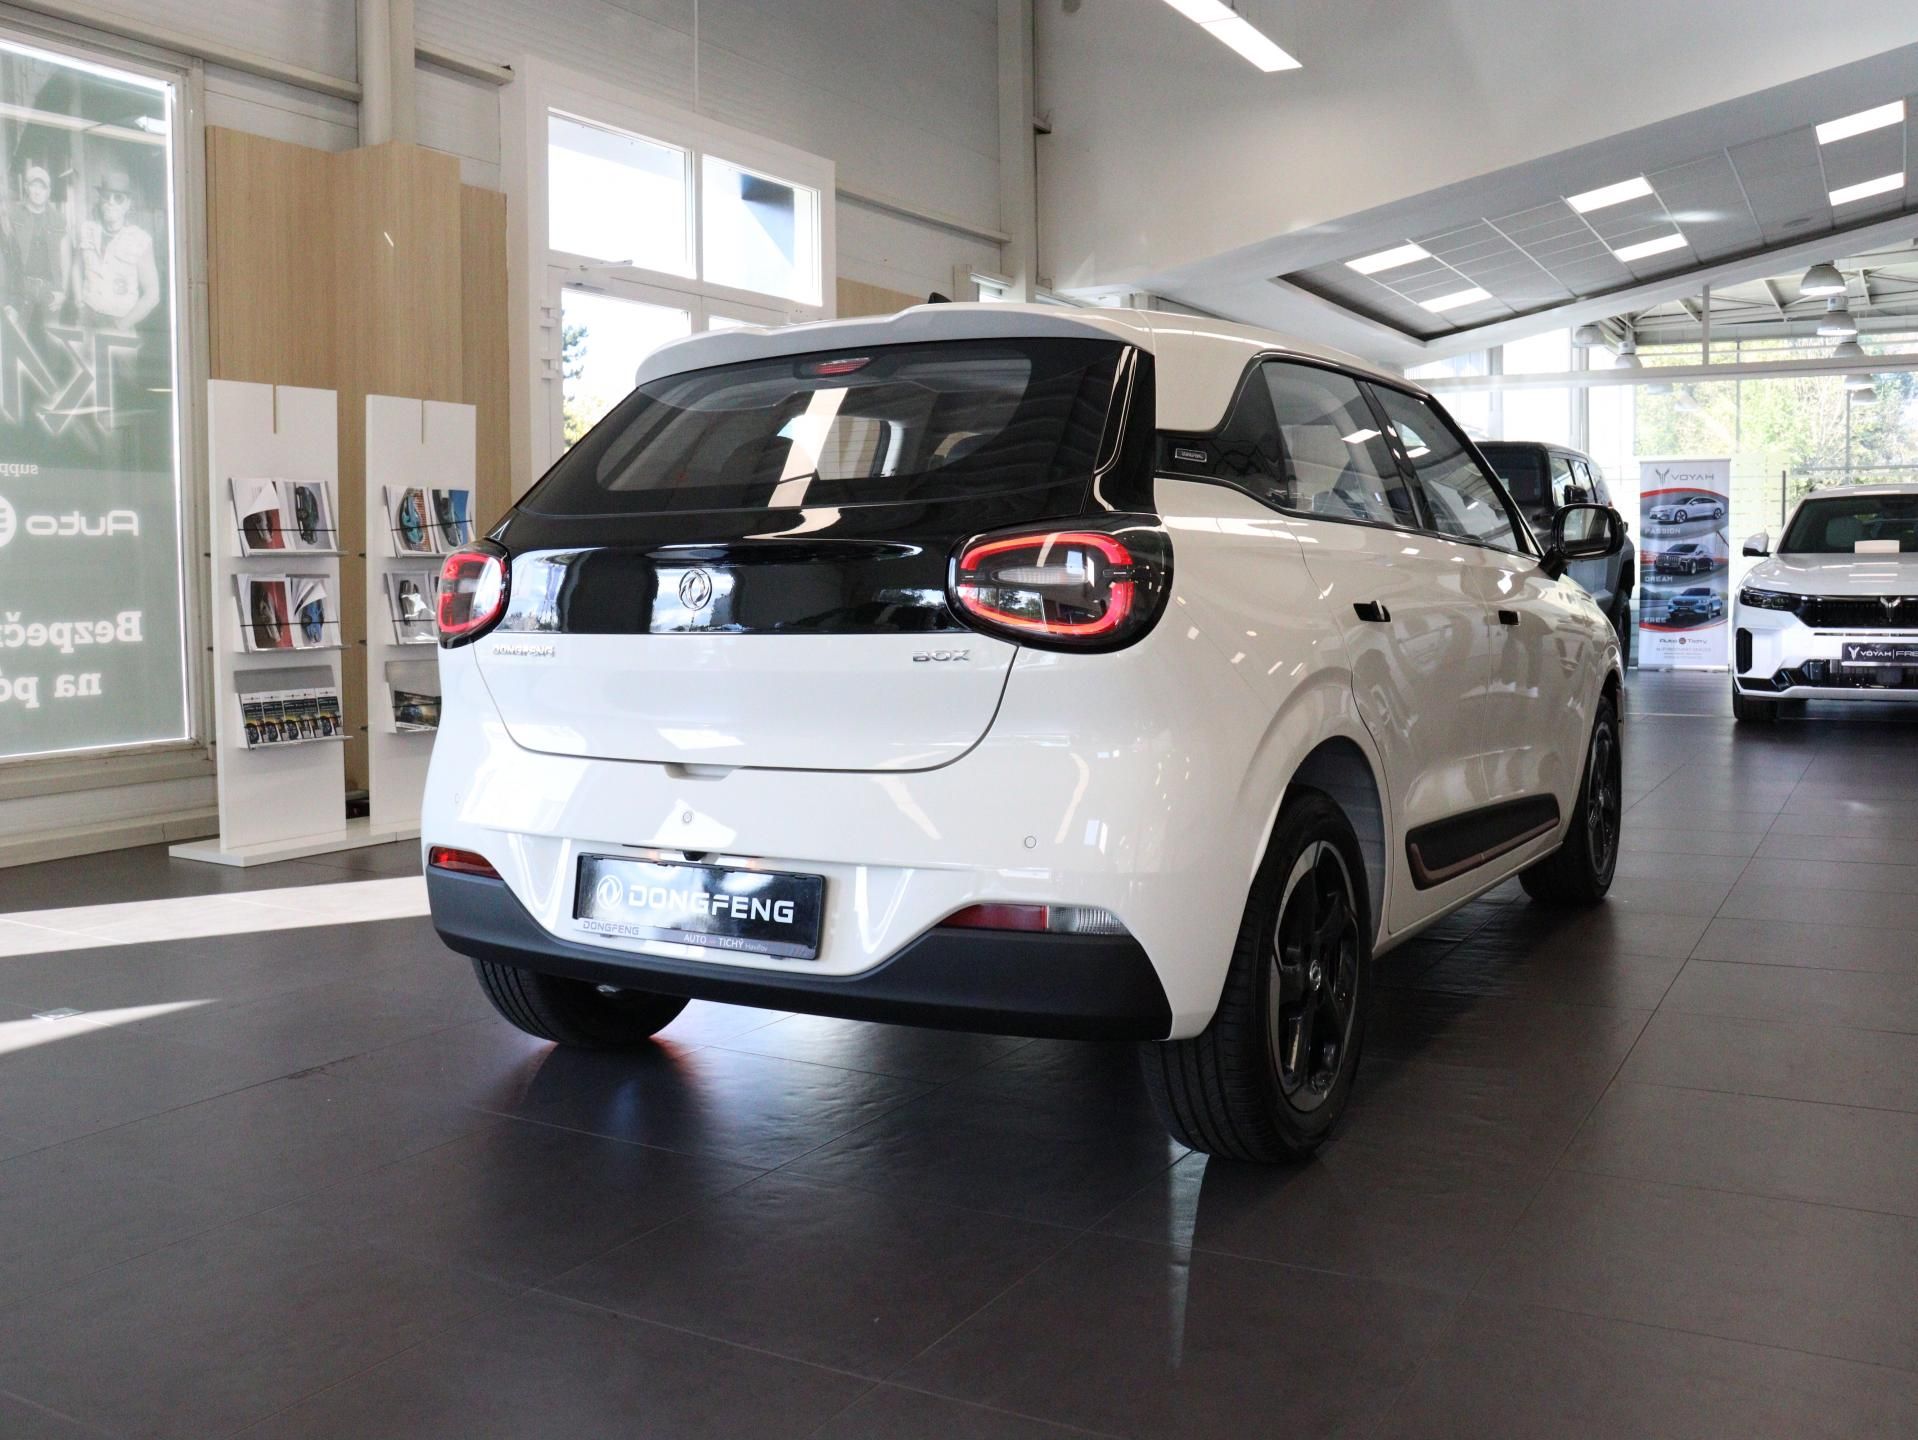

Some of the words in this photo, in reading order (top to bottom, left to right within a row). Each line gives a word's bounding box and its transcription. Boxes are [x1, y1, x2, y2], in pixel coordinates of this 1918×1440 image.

[1671, 473, 1715, 481] VOYAH
[1644, 527, 1681, 535] PASSION
[1644, 575, 1673, 583] DREAM
[912, 648, 970, 662] BOX
[628, 884, 795, 924] DONGFENG
[583, 920, 641, 936] DONGFENG
[683, 933, 707, 945] AUTO
[718, 937, 744, 949] TICHÝ
